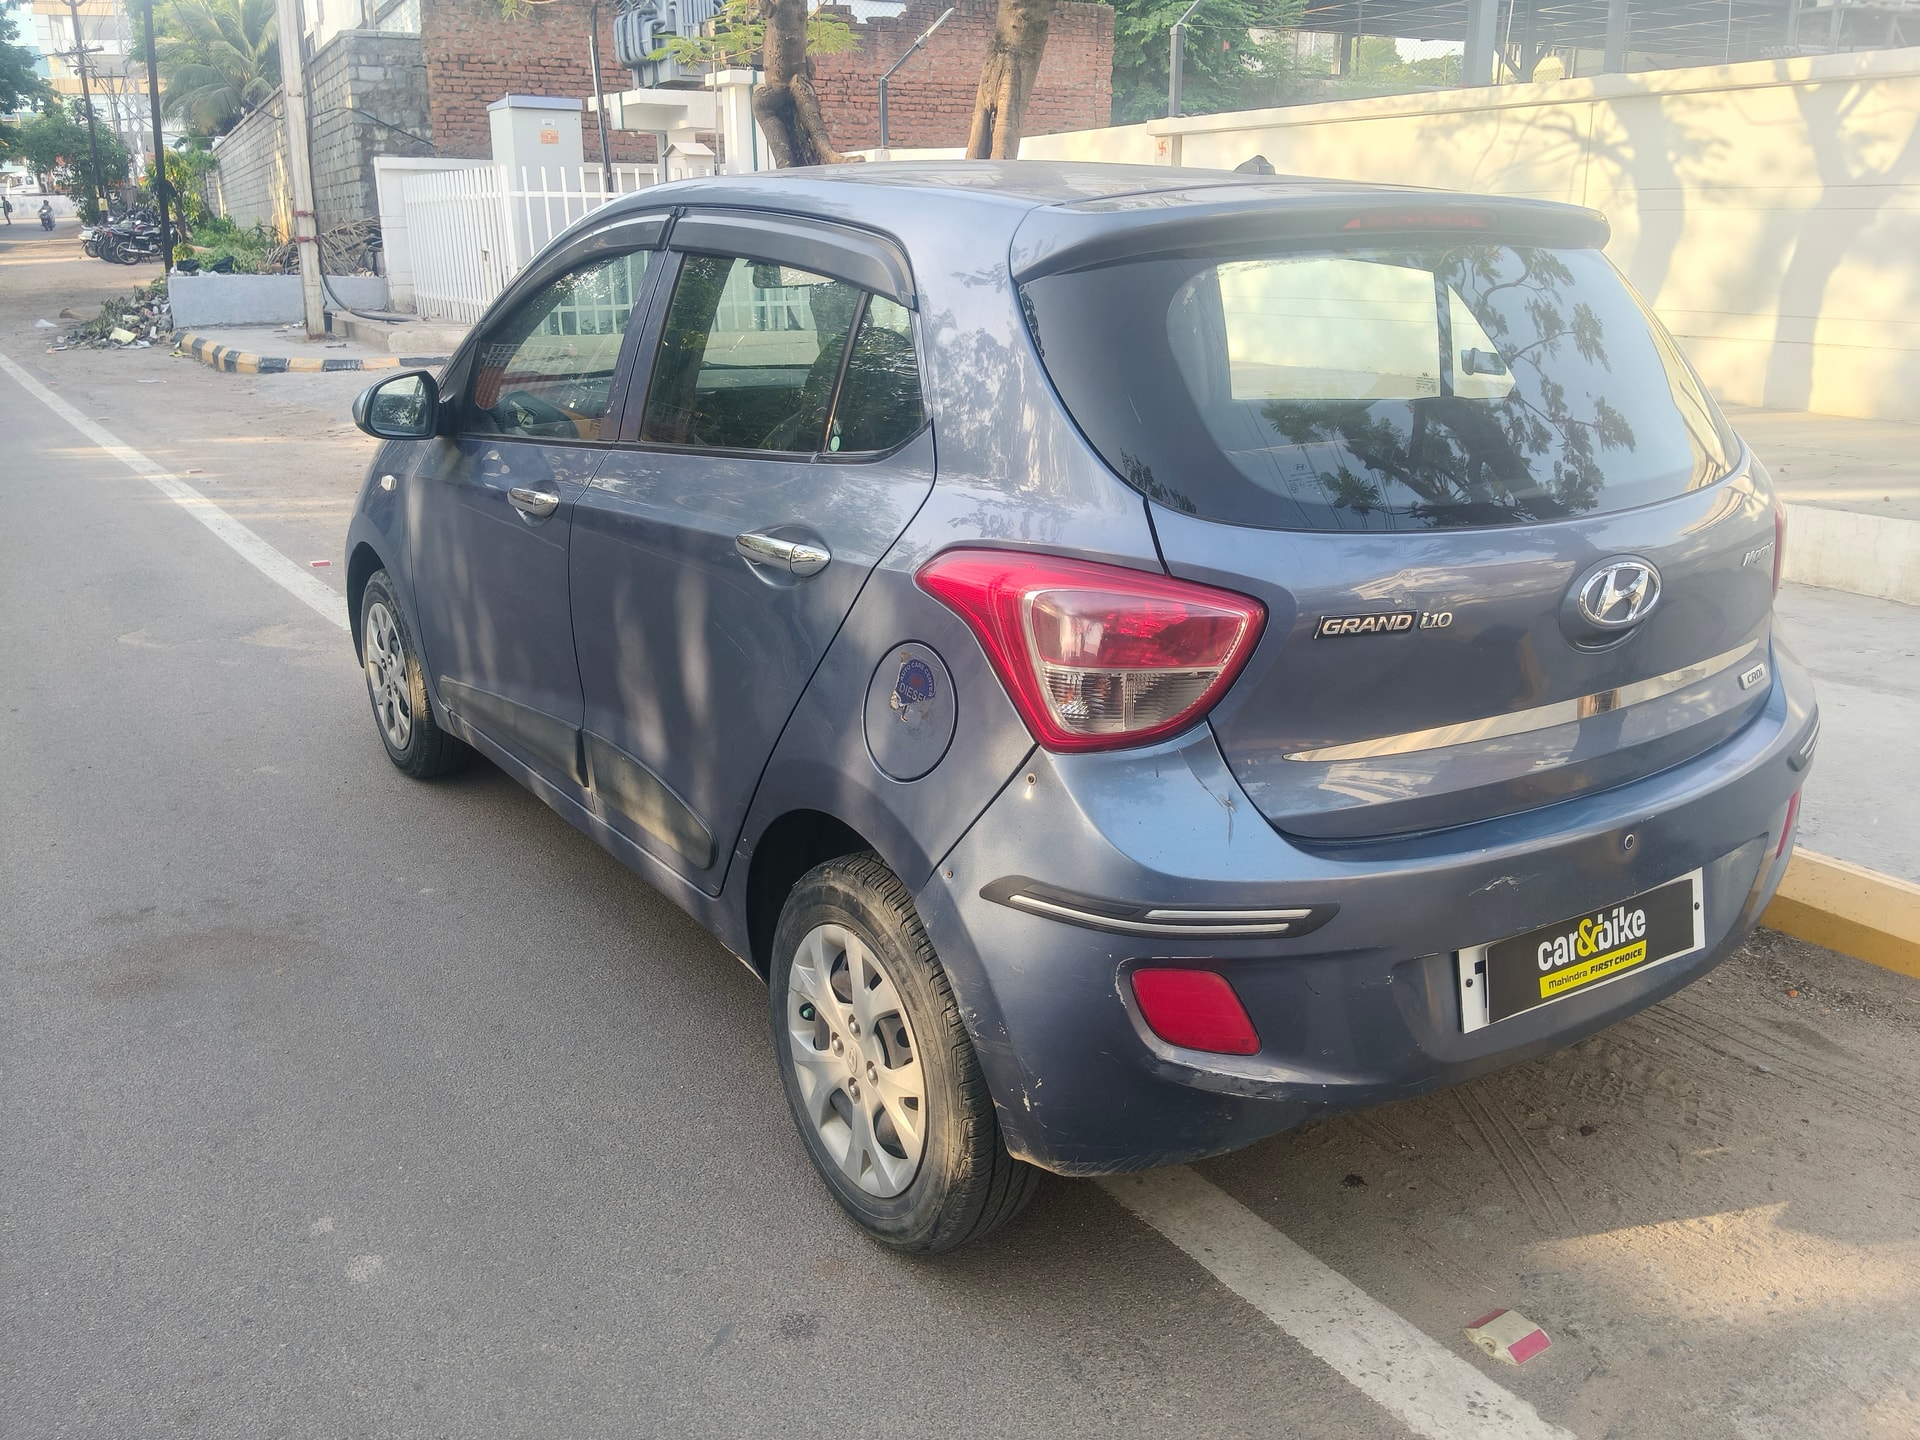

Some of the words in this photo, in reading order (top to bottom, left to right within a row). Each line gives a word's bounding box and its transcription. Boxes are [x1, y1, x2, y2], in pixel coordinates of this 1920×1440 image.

[1322, 614, 1413, 635] GRAND
[1419, 612, 1453, 630] i10
[900, 664, 911, 682] AUTO
[911, 662, 925, 671] CARE
[924, 668, 934, 697] CENTER
[1747, 667, 1763, 684] CRDi
[1537, 906, 1646, 971] car&bike
[1548, 971, 1588, 990] Mahindra
[1589, 959, 1615, 975] FIRST
[1614, 948, 1643, 965] CHOICE
